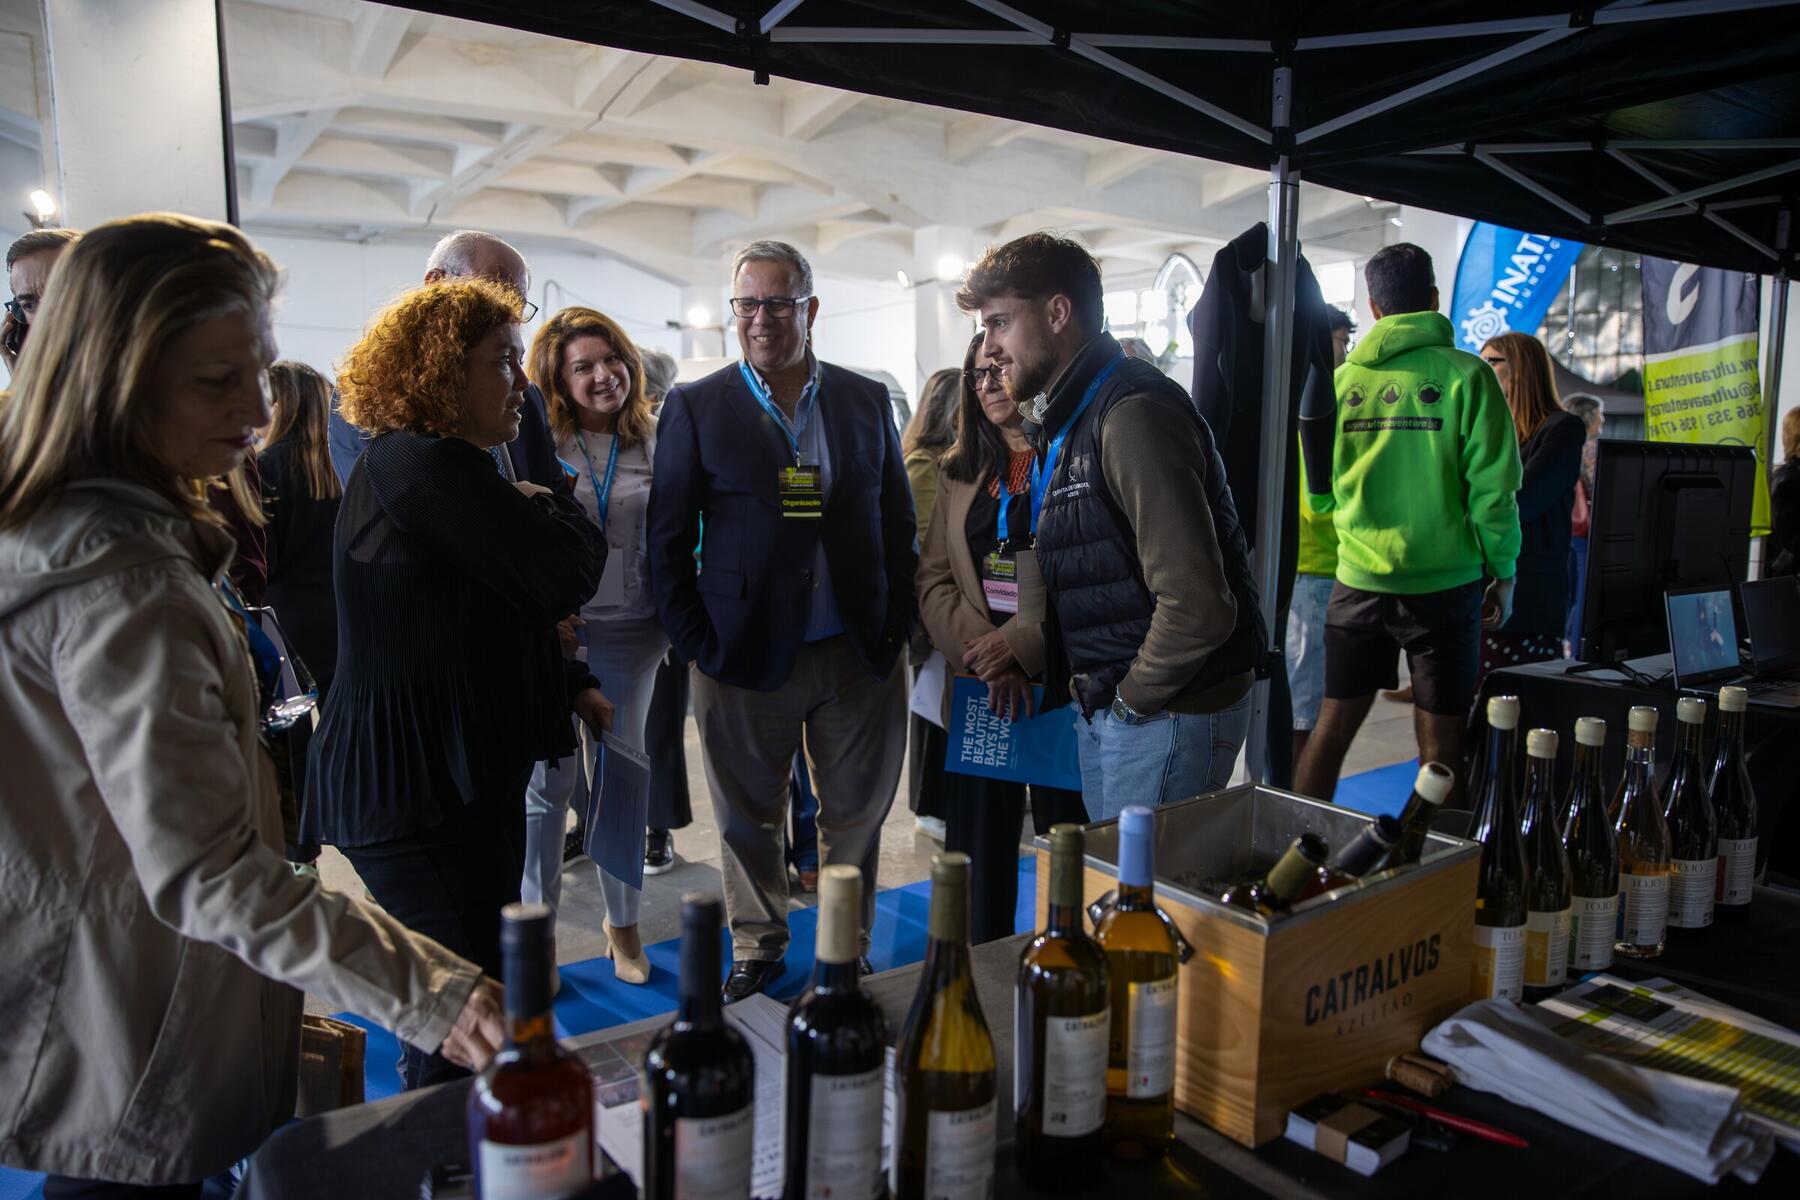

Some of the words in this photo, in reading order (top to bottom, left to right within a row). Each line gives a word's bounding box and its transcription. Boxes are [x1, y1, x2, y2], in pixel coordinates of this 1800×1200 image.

[1491, 233, 1551, 305] INAT
[986, 586, 1018, 598] Convidado
[964, 696, 979, 735] MOST
[988, 715, 1001, 731] IN
[960, 736, 975, 763] THE
[983, 732, 998, 767] BAYS
[995, 741, 1009, 768] THE
[1305, 933, 1441, 1027] CATRALVOS
